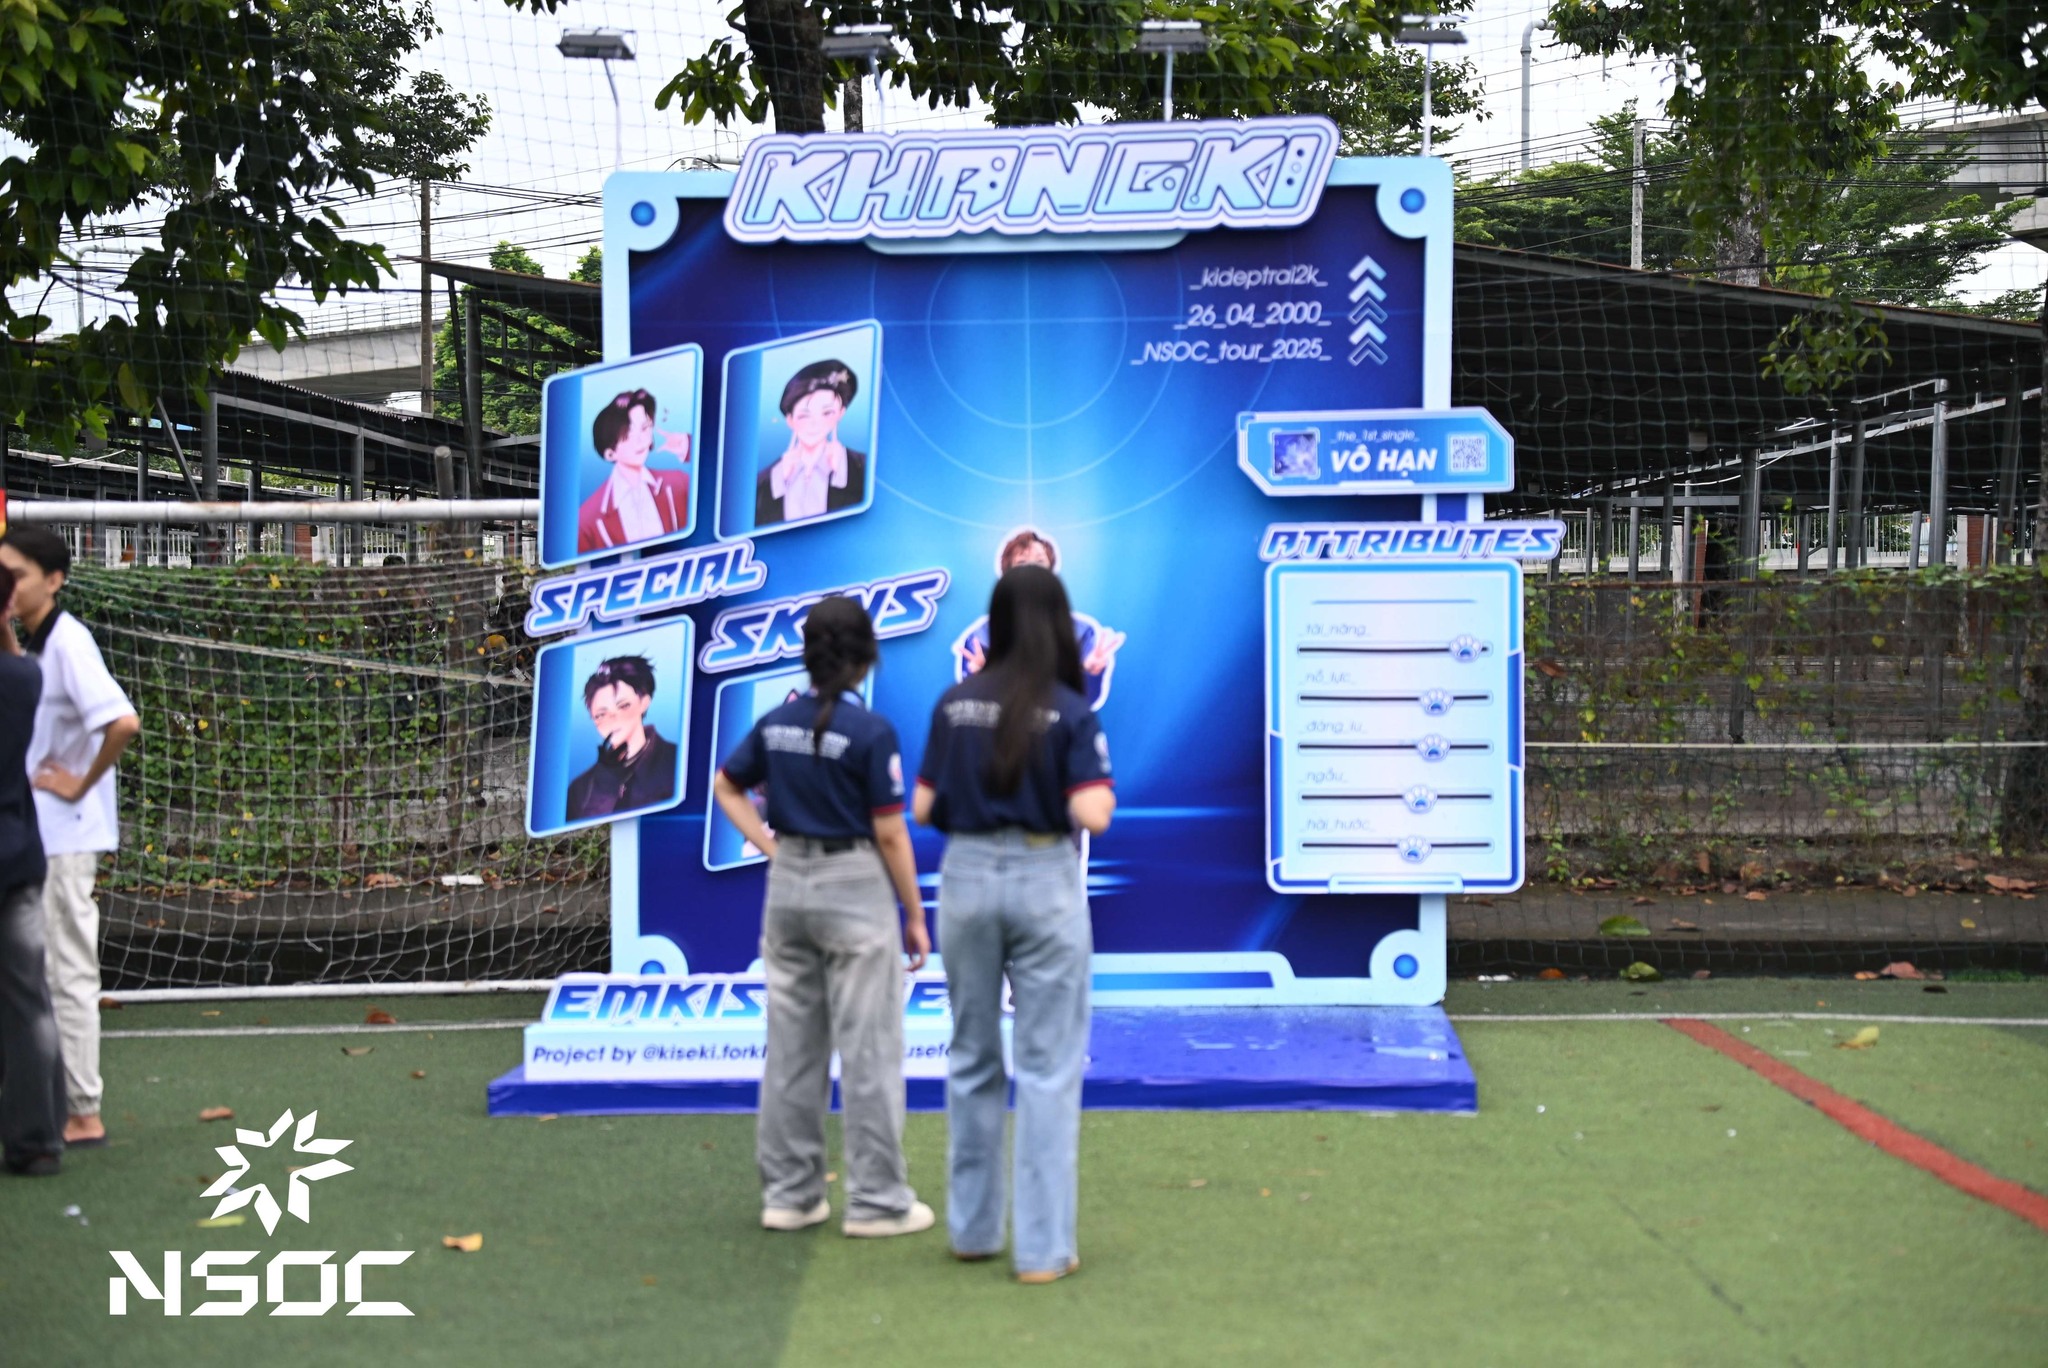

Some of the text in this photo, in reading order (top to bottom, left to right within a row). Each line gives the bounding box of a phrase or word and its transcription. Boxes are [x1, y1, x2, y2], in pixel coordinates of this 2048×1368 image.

[1173, 301, 1332, 330] _26_04_2000_
[1130, 338, 1332, 365] _NSOC_tour_2025_
[1330, 444, 1439, 478] VÔ HẠN
[1261, 526, 1561, 558] ATTRIBUTES
[529, 547, 761, 632] SPECIAL
[533, 1045, 605, 1066] Project
[612, 1044, 637, 1066] by
